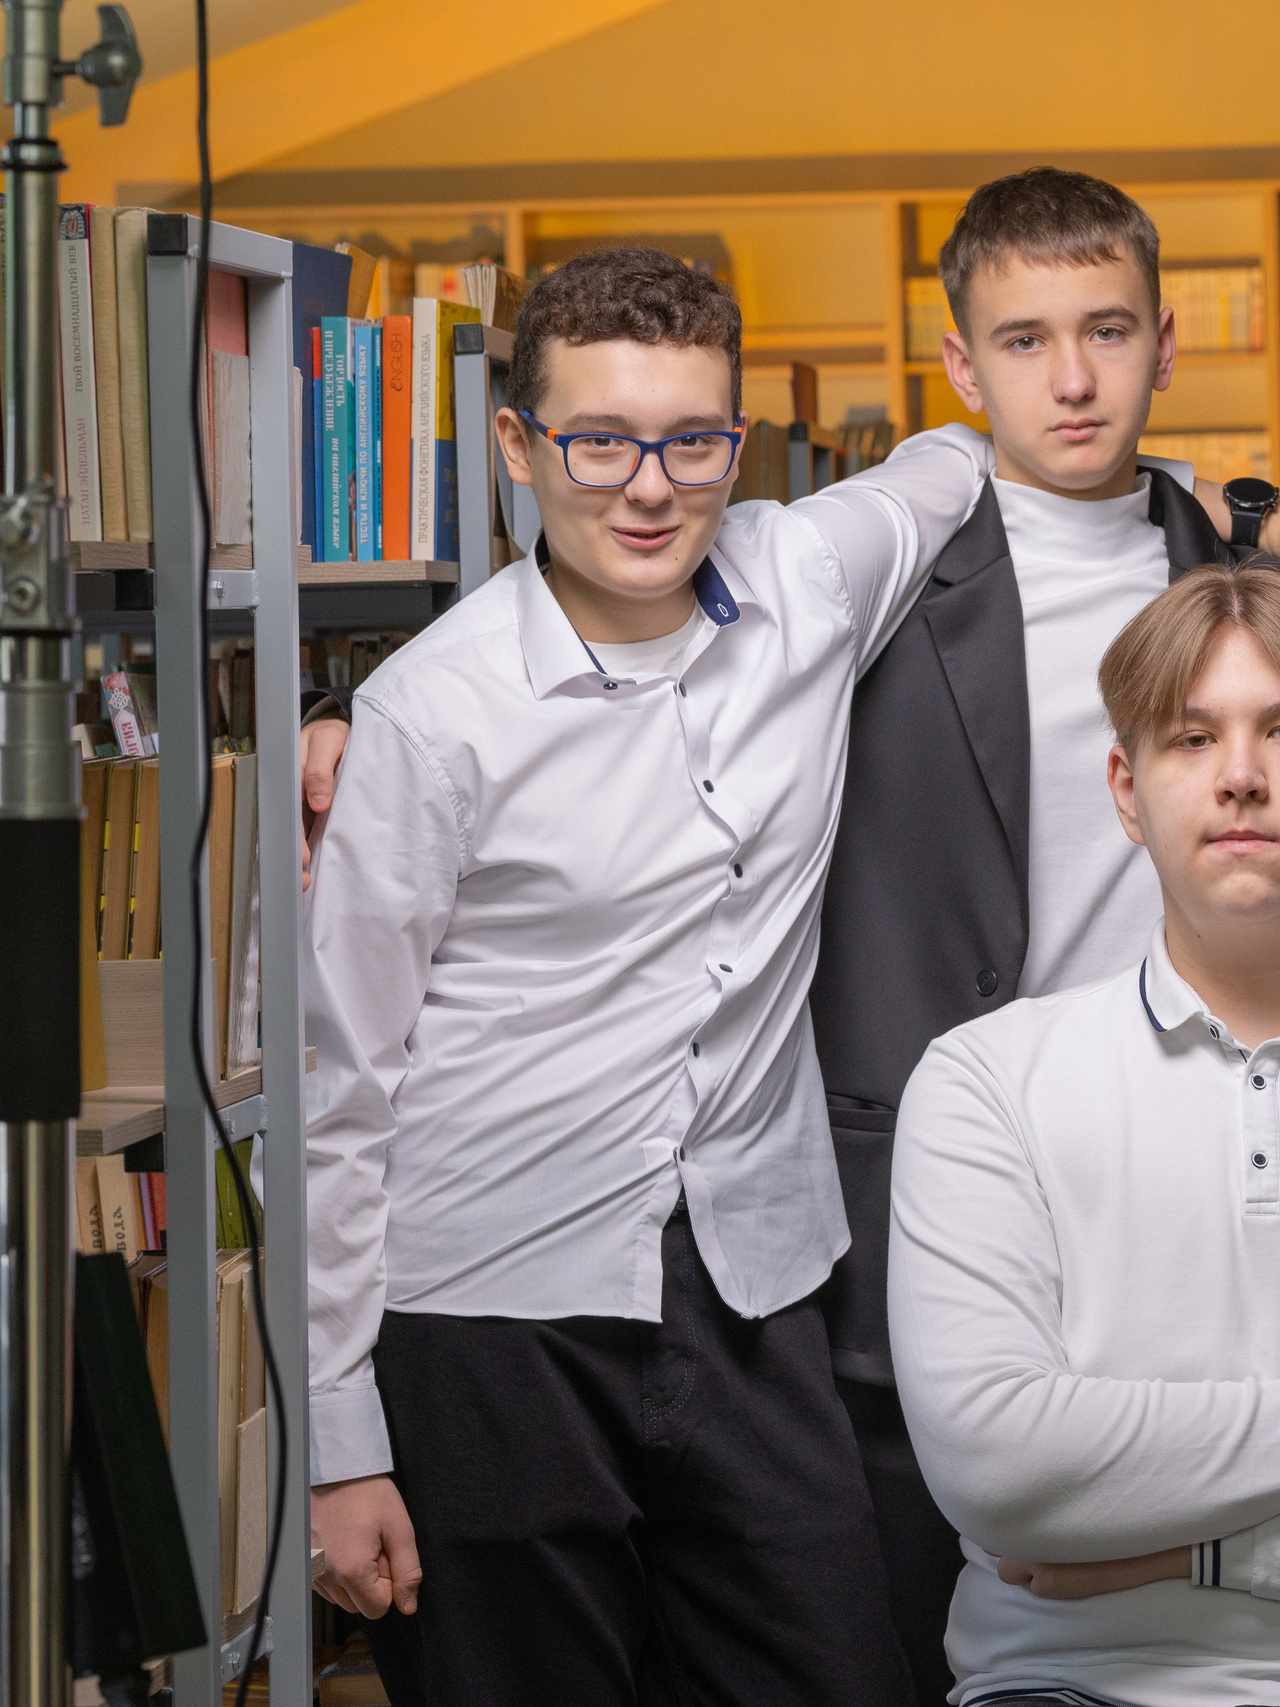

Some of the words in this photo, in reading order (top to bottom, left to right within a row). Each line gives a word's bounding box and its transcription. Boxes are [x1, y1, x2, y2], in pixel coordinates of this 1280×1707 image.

[67, 244, 78, 264] ВЕК
[68, 267, 82, 362] ВОСЕМНАДЦАТЫЙ
[358, 345, 367, 377] ЯЗЫКУ
[391, 333, 403, 392] ENGLISH
[420, 334, 431, 363] ЯЗЫКА
[72, 365, 84, 393] ТВОЙ
[324, 339, 334, 431] ПРЕДУБЕЖДЕНИЕ
[335, 354, 346, 407] ГОРДОСТЬ
[418, 365, 431, 427] АНГЛИЙСКОГО
[358, 379, 368, 448] АНГЛИЙСКОМУ
[75, 417, 90, 486] ЭЙДЕЛЬМАН
[331, 437, 339, 451] на
[359, 451, 368, 464] ПО
[418, 428, 431, 476] ФОНЕТИКА
[330, 453, 343, 514] английском
[360, 467, 368, 501] КЛЮЧИ
[79, 489, 90, 525] НАТАН
[418, 477, 430, 543] ПРАКТИЧЕСКАЯ
[331, 517, 341, 549] языке
[360, 513, 369, 544] ТЕСТЫ
